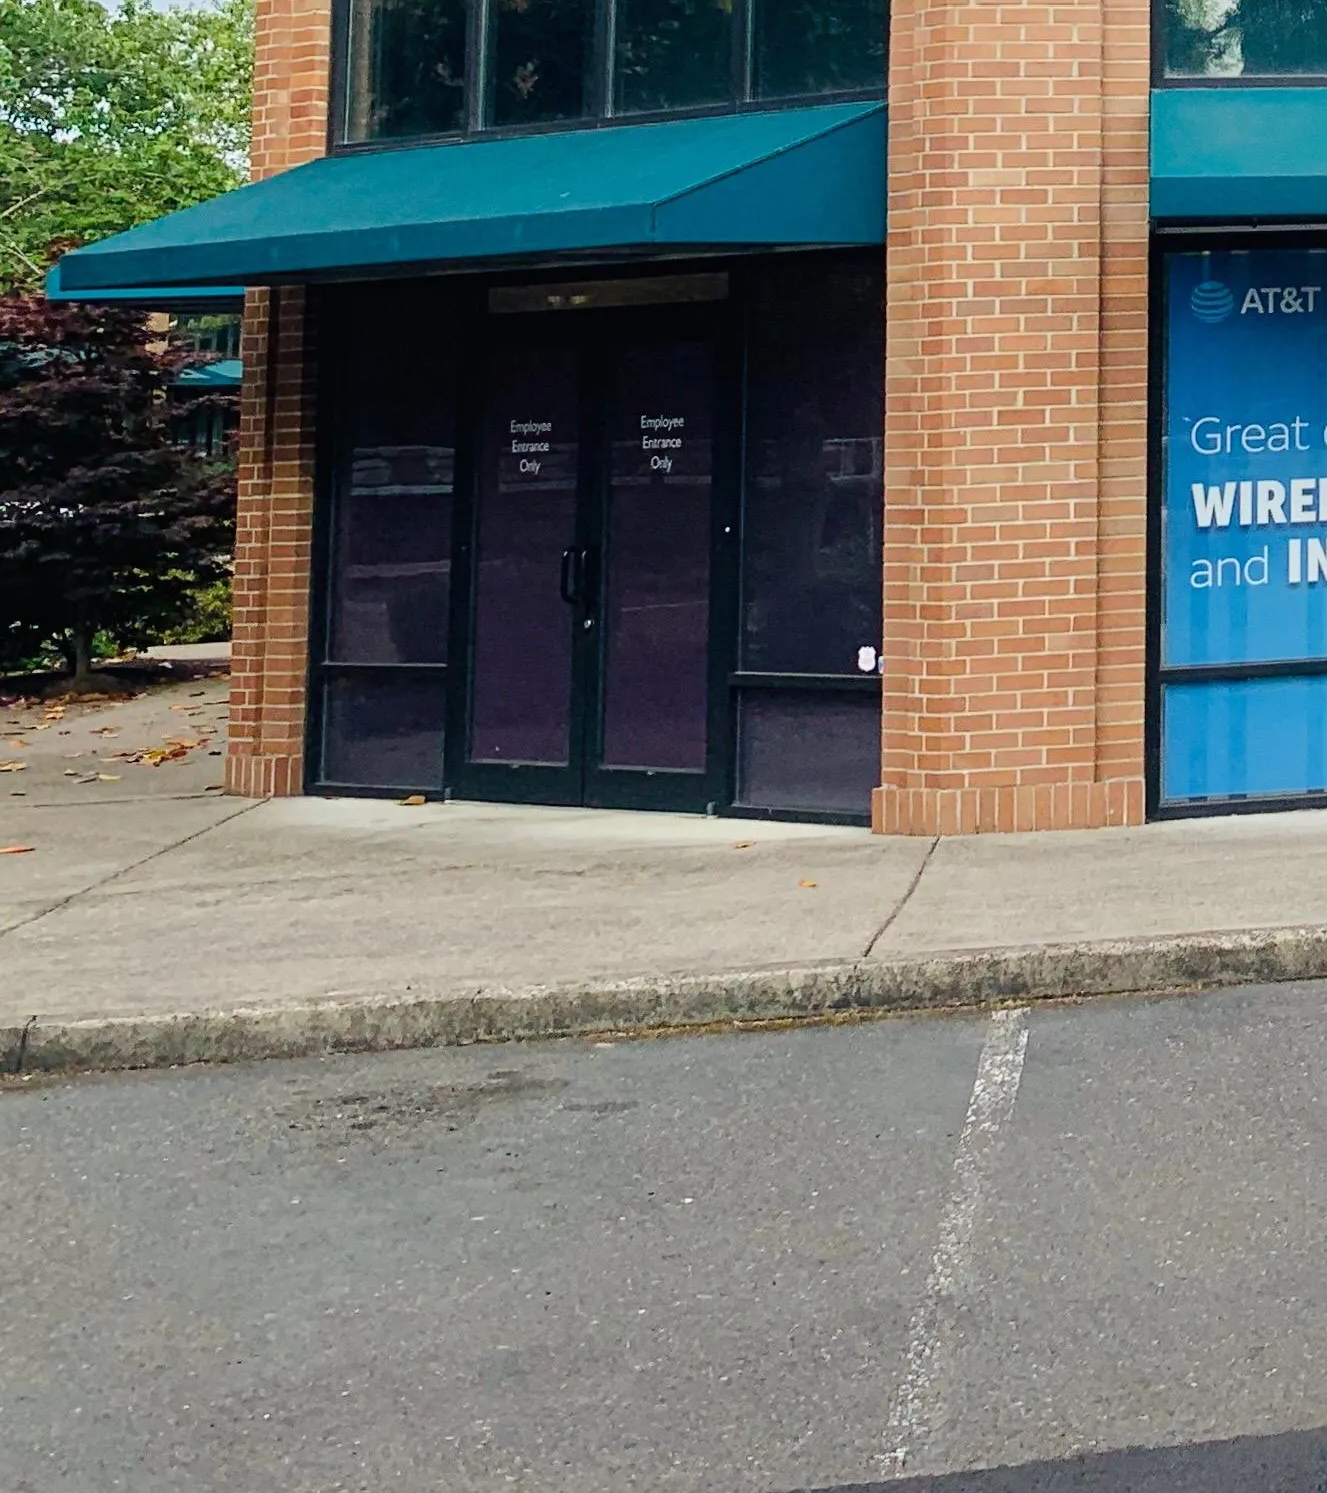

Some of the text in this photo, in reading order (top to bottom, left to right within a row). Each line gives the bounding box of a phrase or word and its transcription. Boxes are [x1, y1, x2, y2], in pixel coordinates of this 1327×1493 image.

[1240, 286, 1321, 314] AT&T
[510, 419, 552, 436] Employee
[640, 415, 685, 432] Employee
[642, 435, 682, 450] Entrance
[1191, 415, 1310, 455] Great
[512, 439, 550, 453] Entrance
[519, 459, 542, 475] Only
[650, 456, 673, 473] Only
[1190, 545, 1269, 589] and
